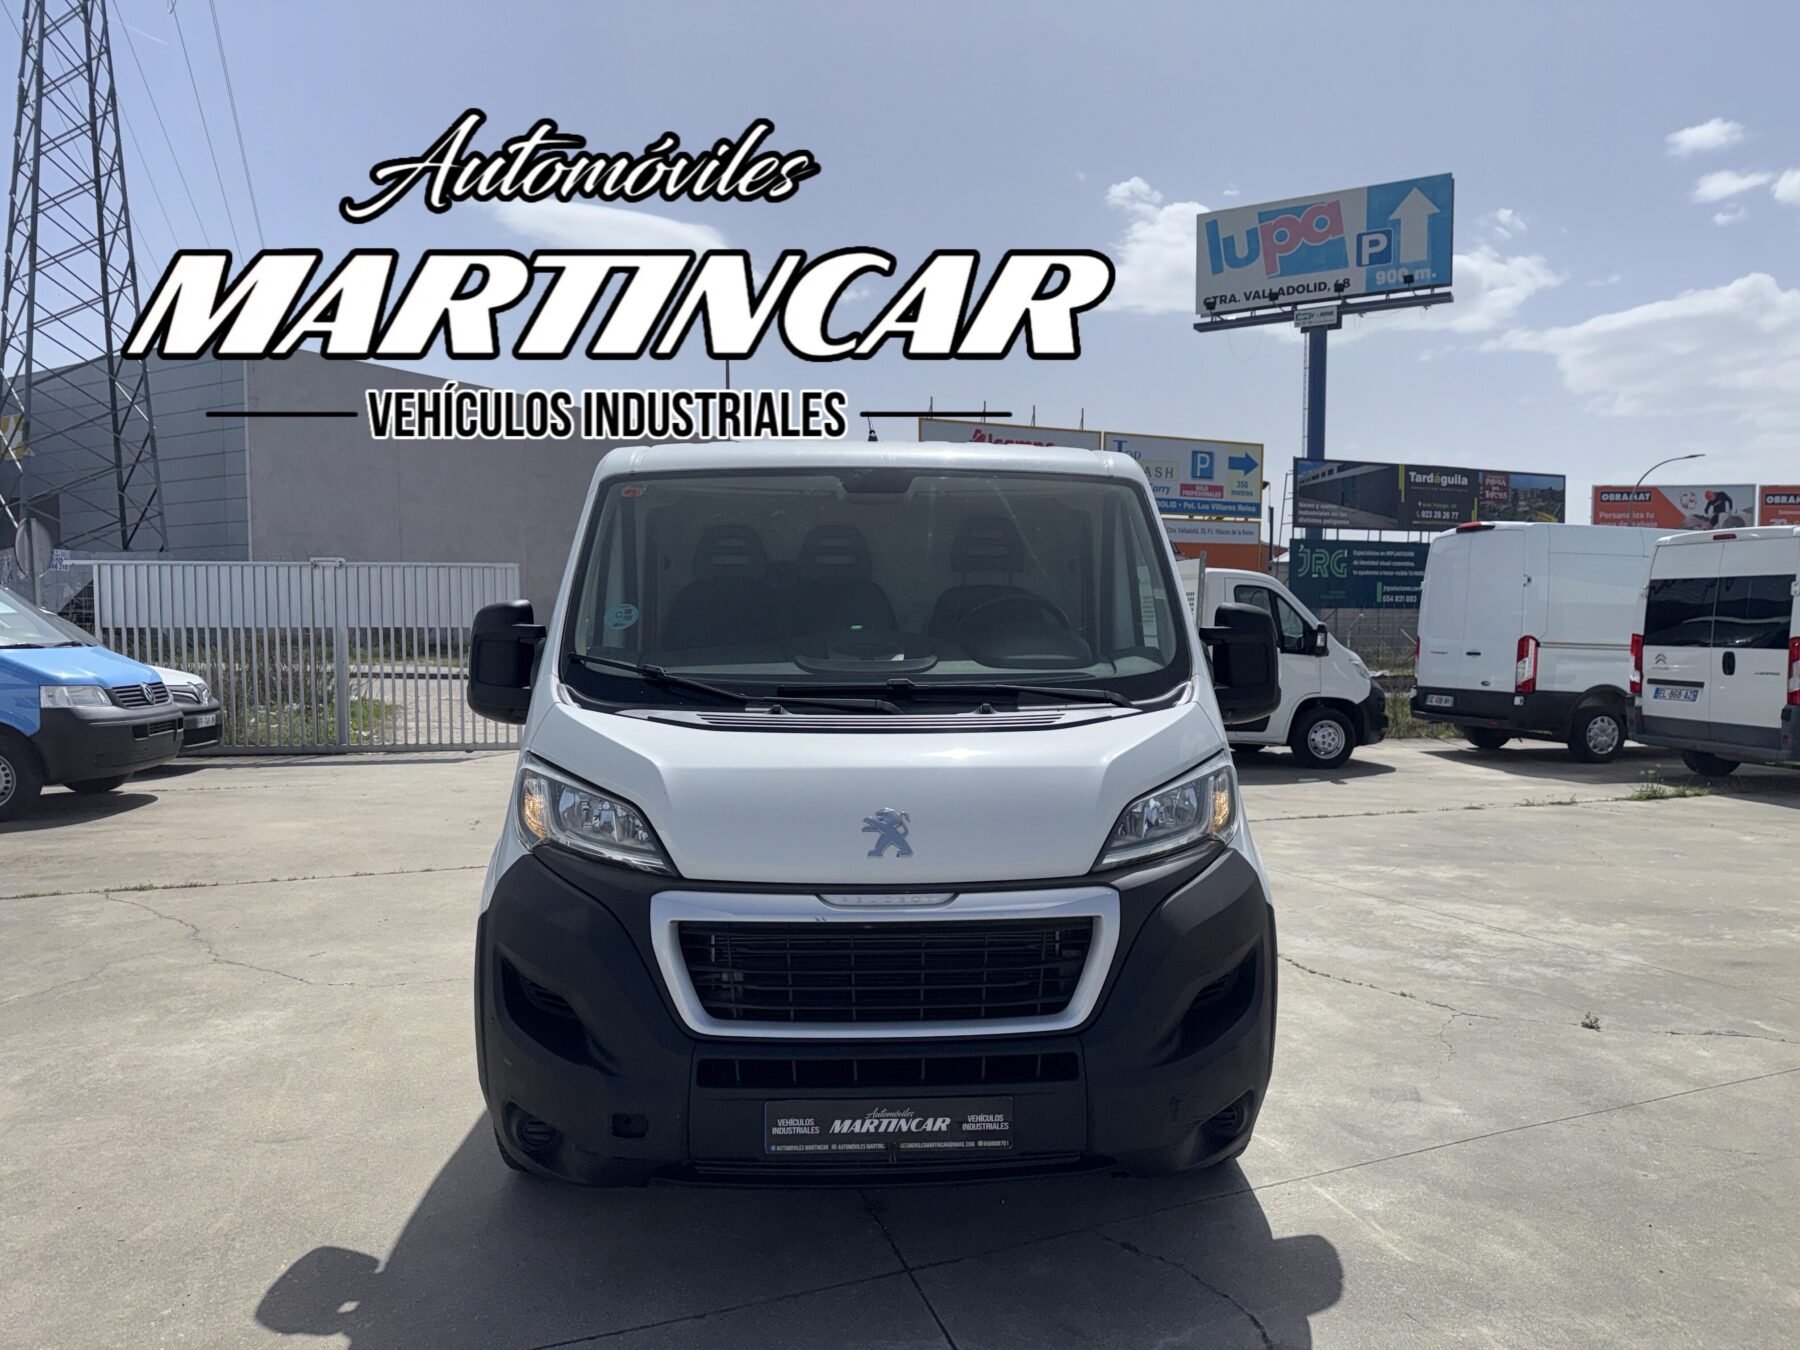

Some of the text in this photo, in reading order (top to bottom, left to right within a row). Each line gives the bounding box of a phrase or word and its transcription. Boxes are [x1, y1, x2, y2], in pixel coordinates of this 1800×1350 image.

[1205, 200, 1344, 278] lupa
[1362, 233, 1388, 265] P
[1144, 466, 1173, 479] ASH
[1409, 472, 1468, 487] Tardáguila
[772, 1126, 820, 1135] INDUSTRIALES
[829, 1117, 951, 1134] MARTINCAR
[962, 1122, 1009, 1131] INDUSTRIALES
